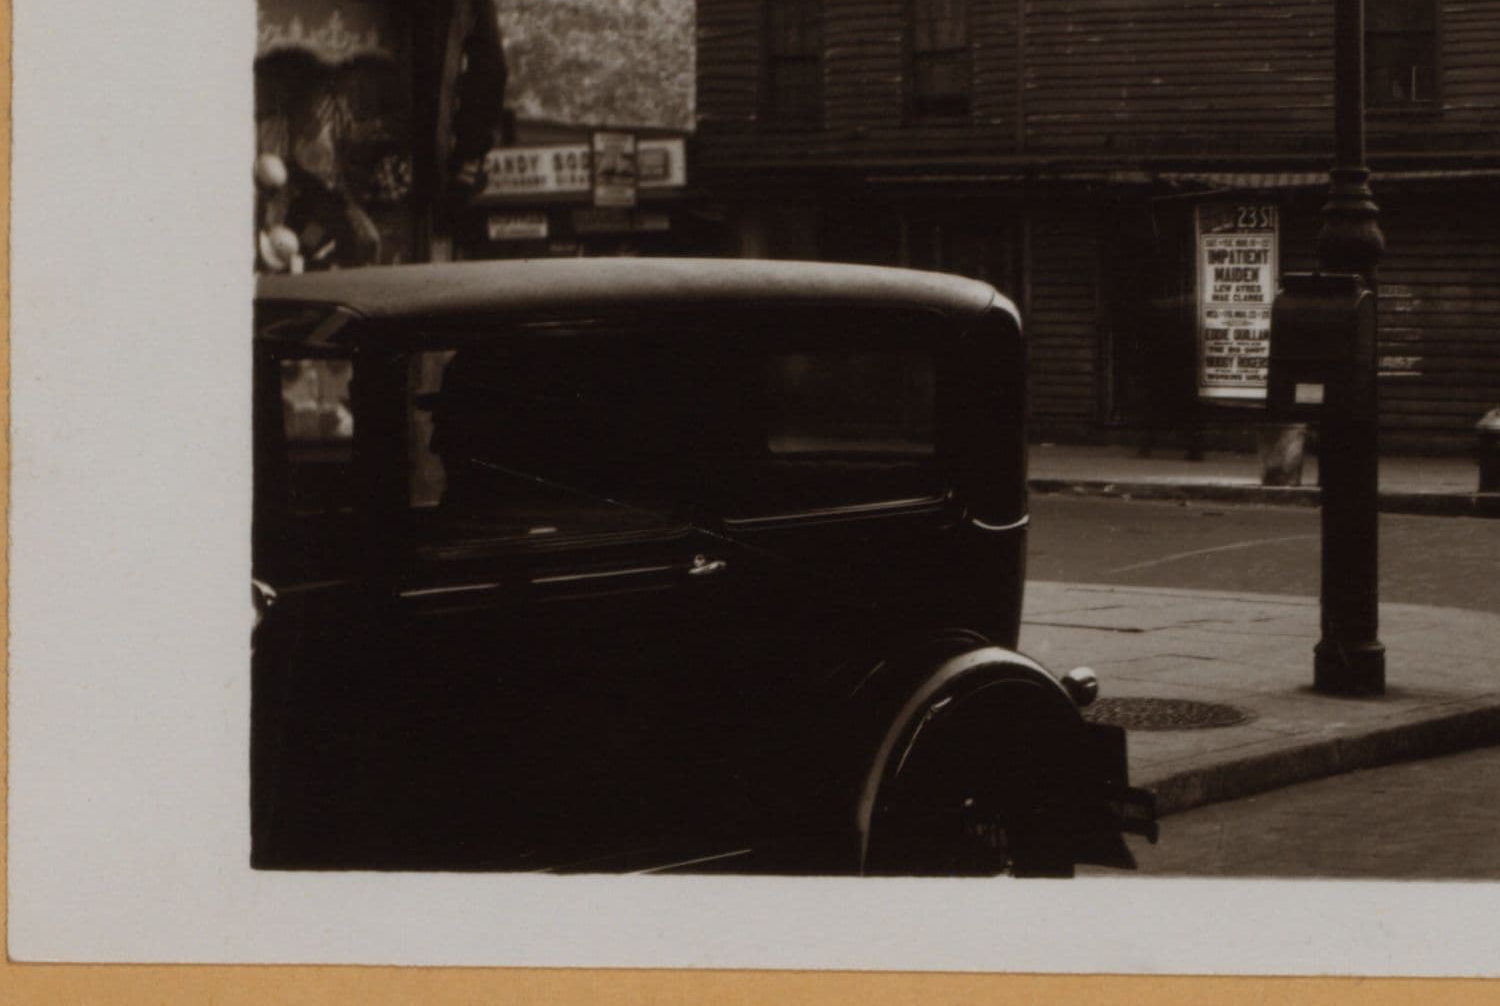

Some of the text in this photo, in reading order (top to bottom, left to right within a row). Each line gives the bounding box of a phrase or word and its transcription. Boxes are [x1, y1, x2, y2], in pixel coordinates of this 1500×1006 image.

[1237, 206, 1255, 228] 23
[1207, 249, 1269, 265] IMPATIENT
[1214, 267, 1260, 283] MAIDEN
